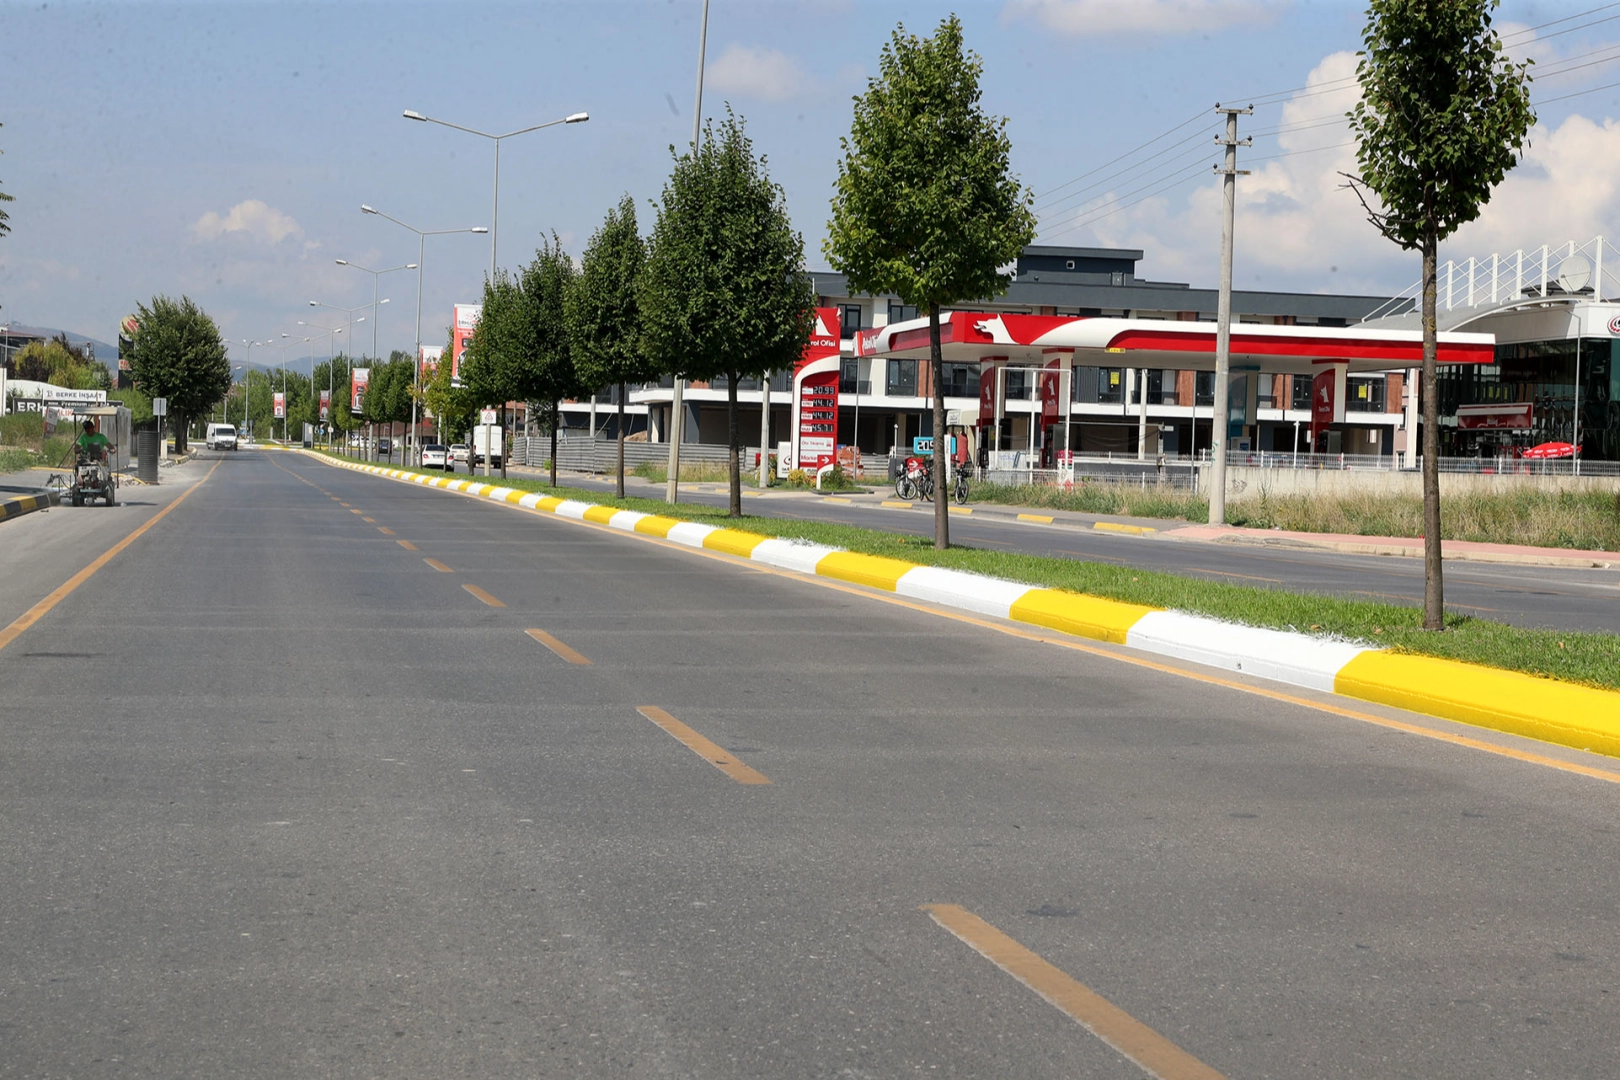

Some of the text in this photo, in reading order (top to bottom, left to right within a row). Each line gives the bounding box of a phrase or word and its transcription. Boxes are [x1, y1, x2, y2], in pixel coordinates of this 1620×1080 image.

[820, 339, 836, 347] Ofisi
[813, 386, 834, 394] 20.99
[813, 399, 833, 407] 44.12
[812, 411, 833, 419] 44.12
